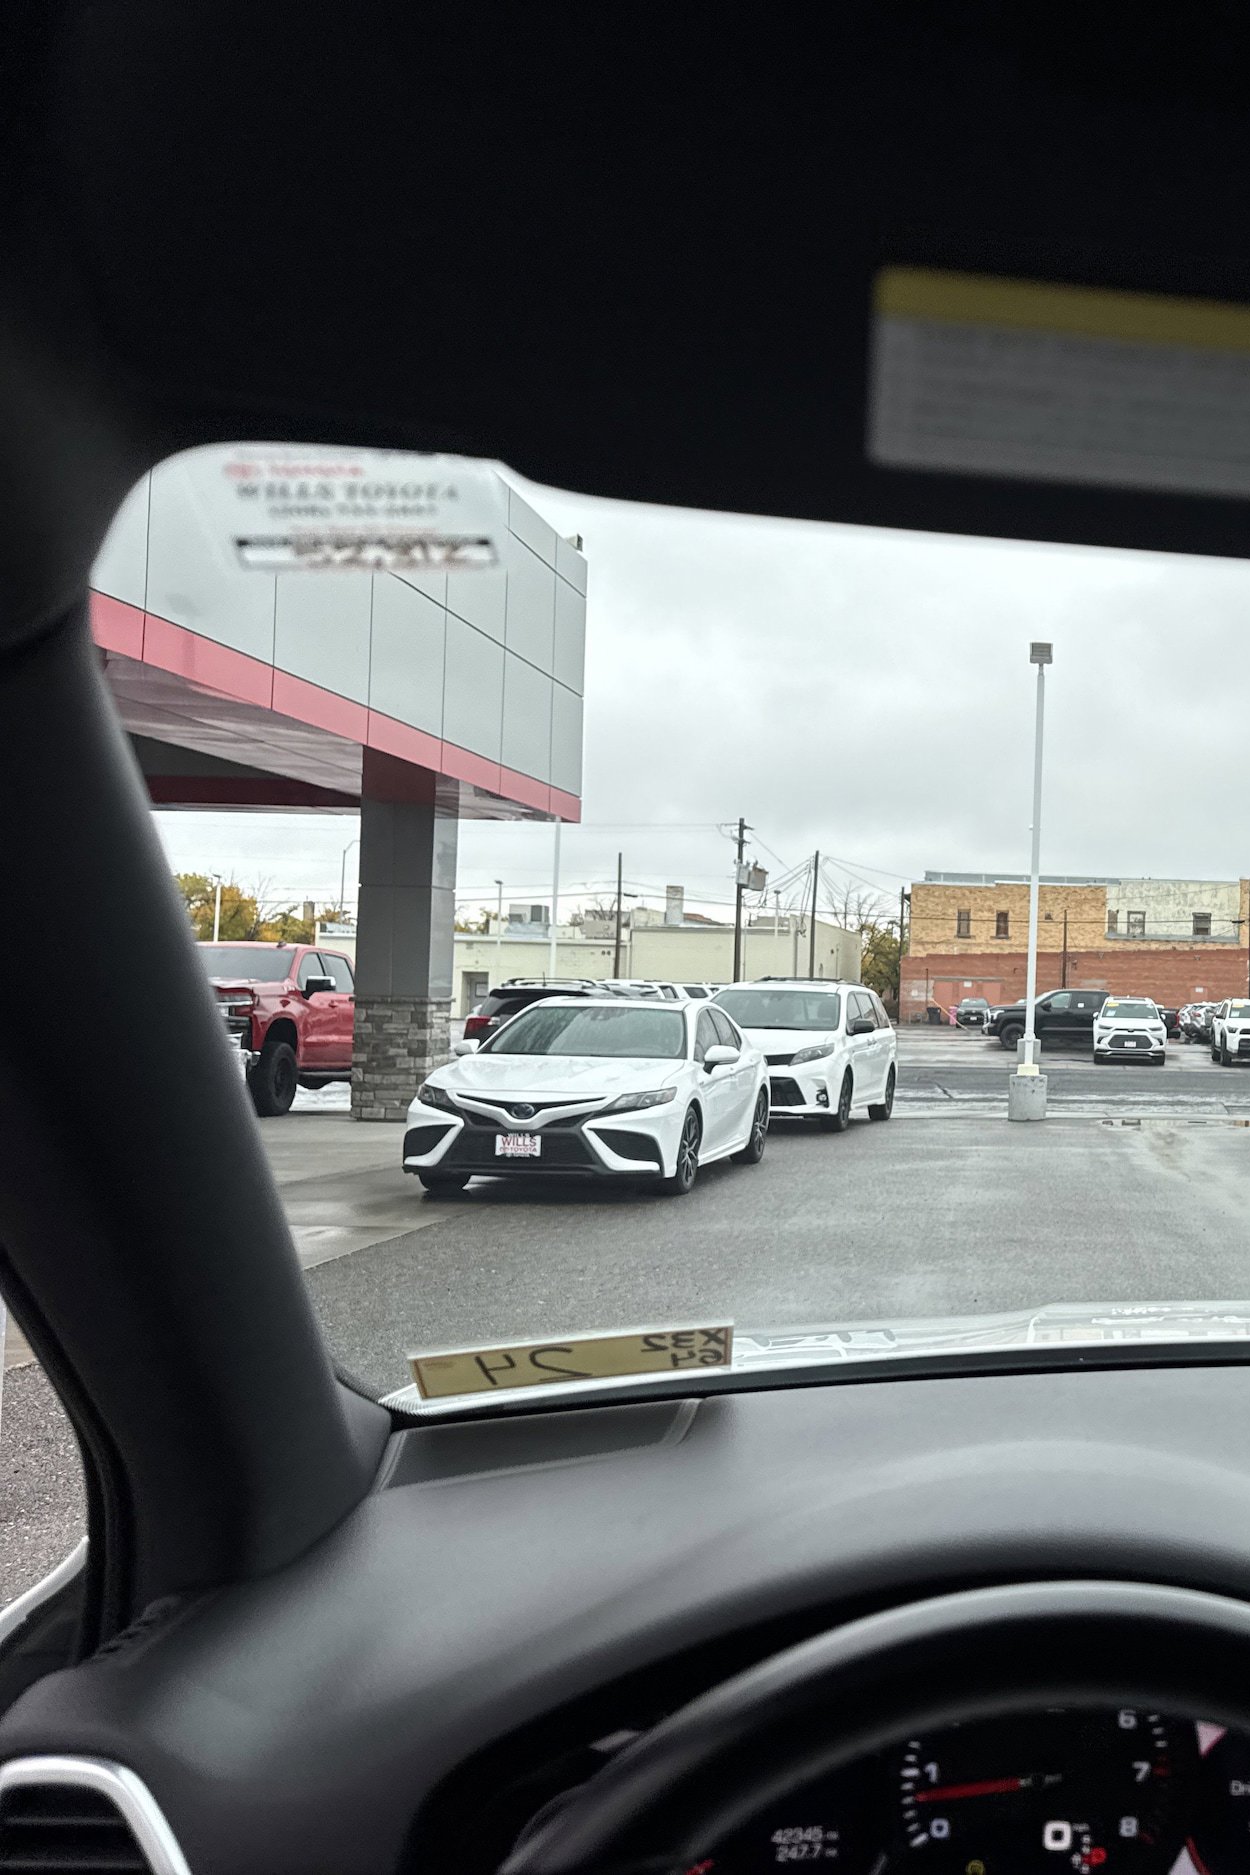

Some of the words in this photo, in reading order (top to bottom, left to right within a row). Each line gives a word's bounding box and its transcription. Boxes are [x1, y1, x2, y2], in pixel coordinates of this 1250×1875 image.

[501, 1137, 537, 1147] WILLS
[1118, 1709, 1137, 1730] 6
[923, 1762, 940, 1784] 1
[1132, 1761, 1151, 1783] 7
[930, 1817, 950, 1839] 0
[1042, 1818, 1073, 1852] 0
[1119, 1816, 1138, 1838] 8
